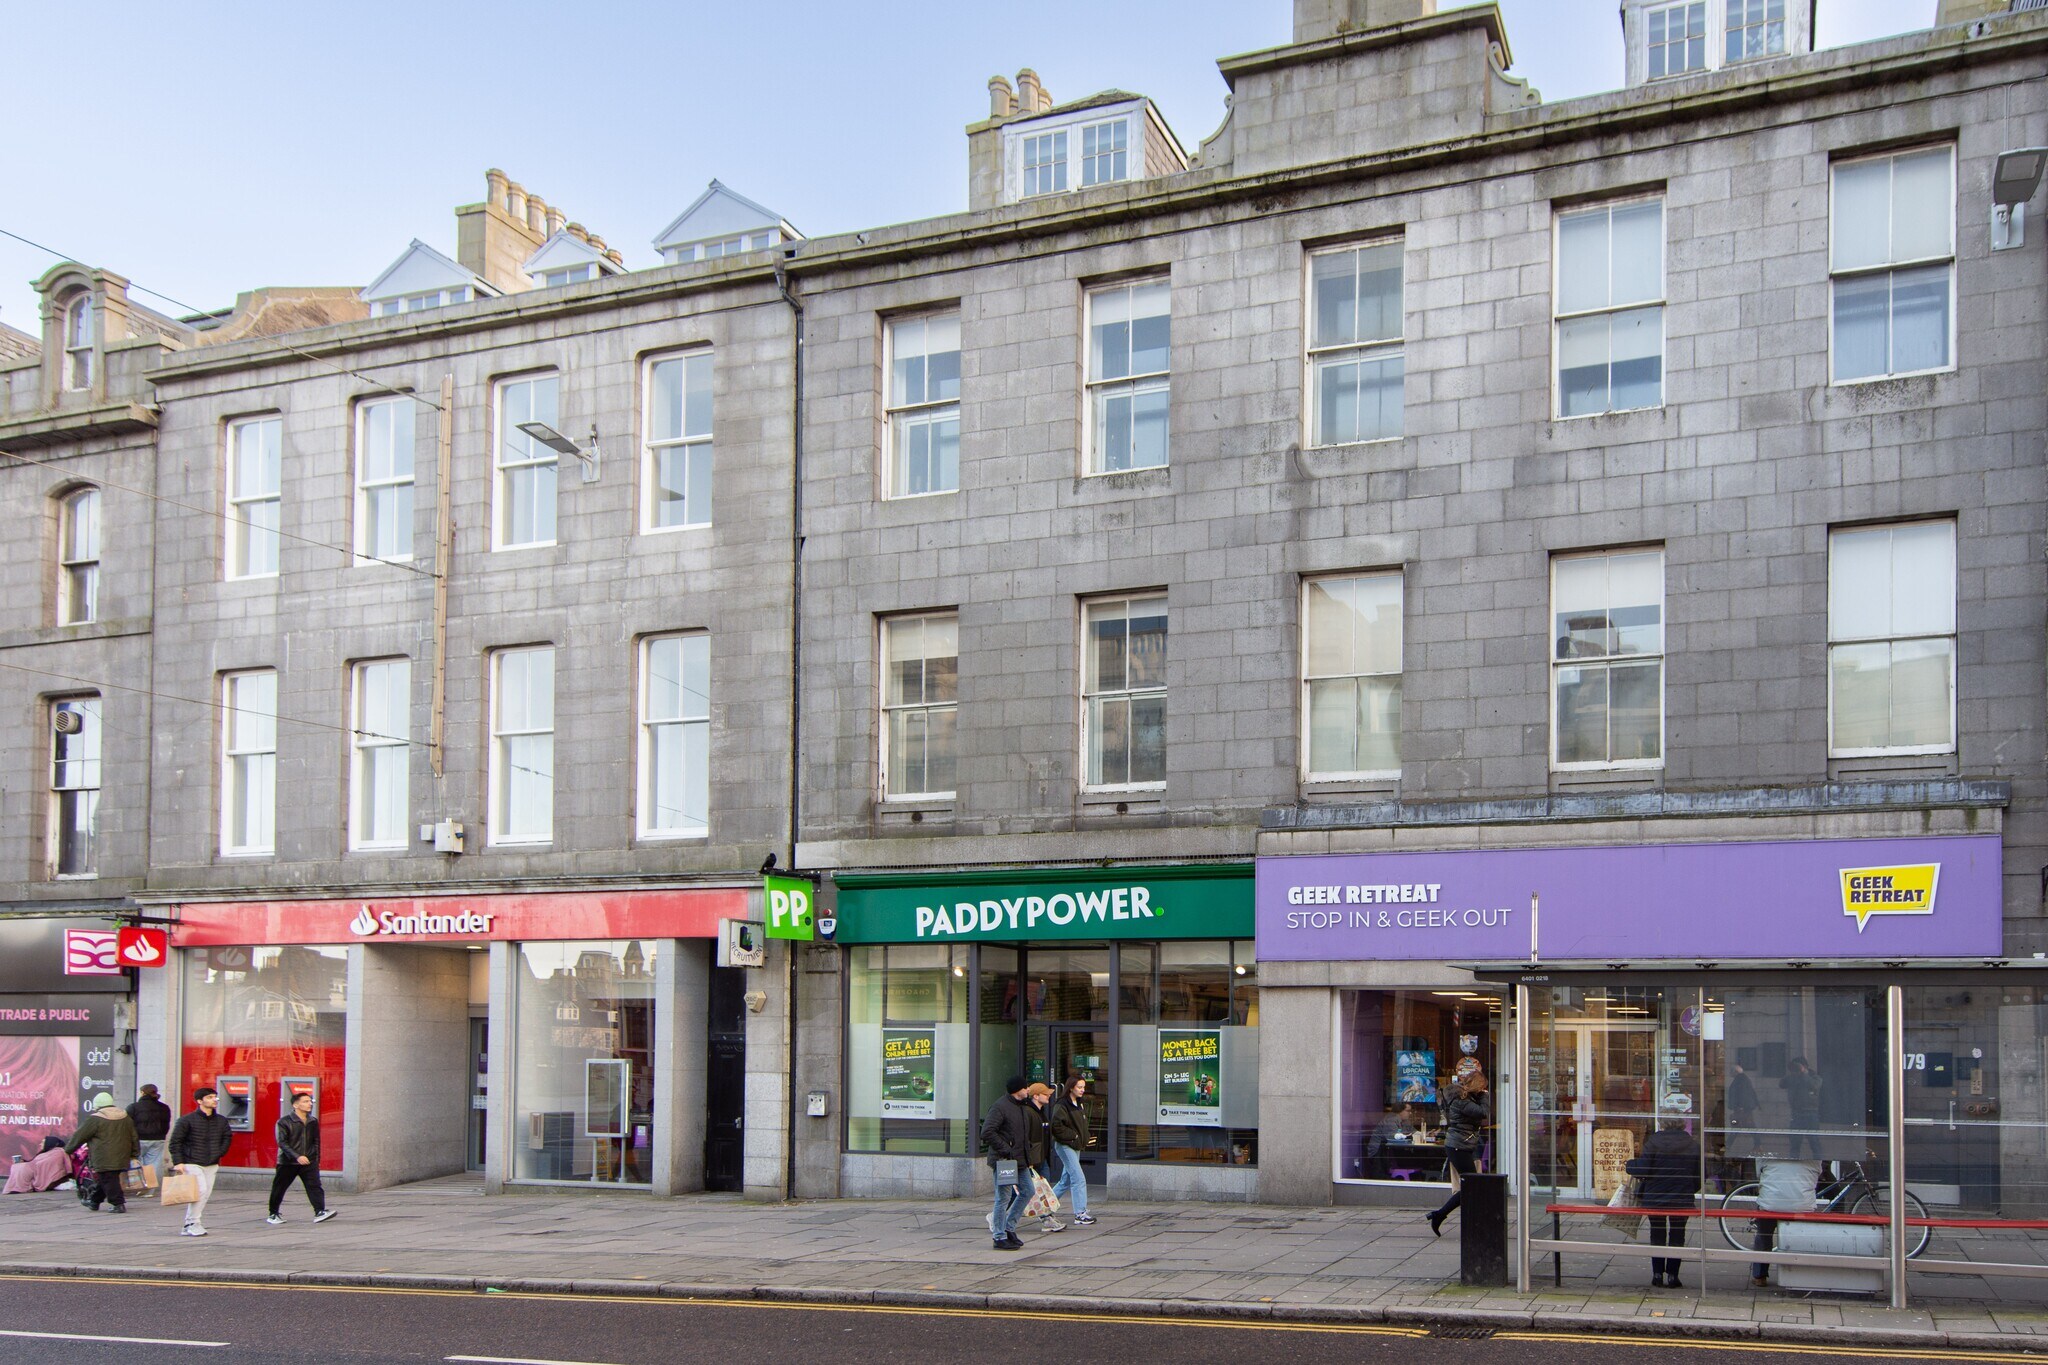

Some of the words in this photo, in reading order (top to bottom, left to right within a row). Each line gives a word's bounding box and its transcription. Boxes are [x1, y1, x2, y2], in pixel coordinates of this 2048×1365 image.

[1850, 876, 1893, 889] GEEK
[1288, 886, 1342, 904] GEEK
[1346, 884, 1441, 903] RETREAT
[1850, 889, 1924, 902] RETREAT
[380, 910, 494, 934] Santander
[1287, 911, 1342, 929] STOP
[1349, 911, 1370, 928] IN
[1377, 911, 1391, 928] &
[1397, 910, 1458, 928] GEEK
[1463, 908, 1512, 927] OUT
[731, 941, 763, 962] RECRUITMENT
[0, 1008, 37, 1020] TRADE
[38, 1008, 46, 1020] &
[49, 1008, 90, 1021] PUBLIC
[886, 1042, 902, 1051] GET
[915, 1039, 930, 1049] £10
[1162, 1040, 1192, 1050] MONEY
[1194, 1038, 1216, 1047] BACK
[87, 1047, 110, 1066] ghd
[886, 1050, 906, 1058] ONLINE
[1163, 1049, 1173, 1058] AS
[1184, 1048, 1201, 1056] FREE
[1204, 1046, 1217, 1054] BET
[8, 1116, 27, 1125] AND
[29, 1116, 63, 1125] BEAUTY
